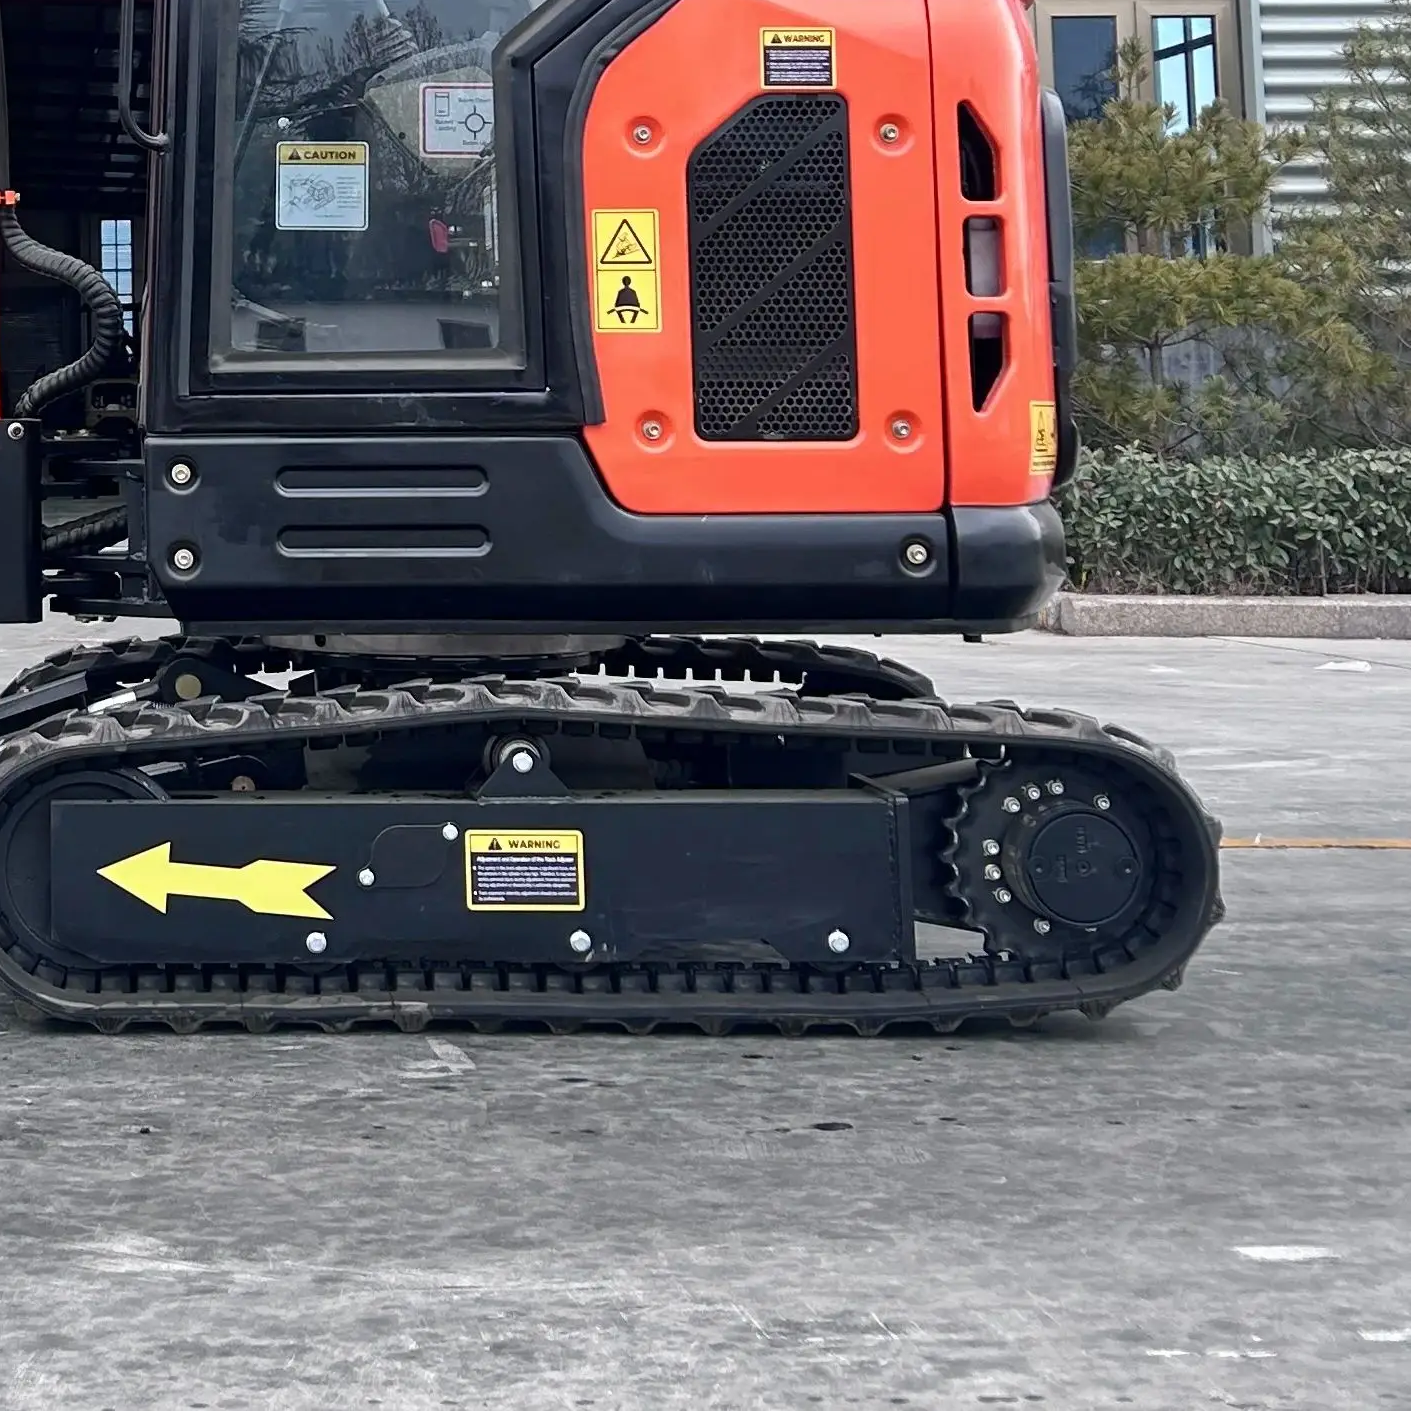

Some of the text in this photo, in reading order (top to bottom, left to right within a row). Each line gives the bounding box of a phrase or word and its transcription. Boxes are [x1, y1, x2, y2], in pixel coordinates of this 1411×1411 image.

[783, 34, 825, 43] WARNING
[304, 151, 357, 160] CAUTION
[508, 840, 561, 849] WARNING
